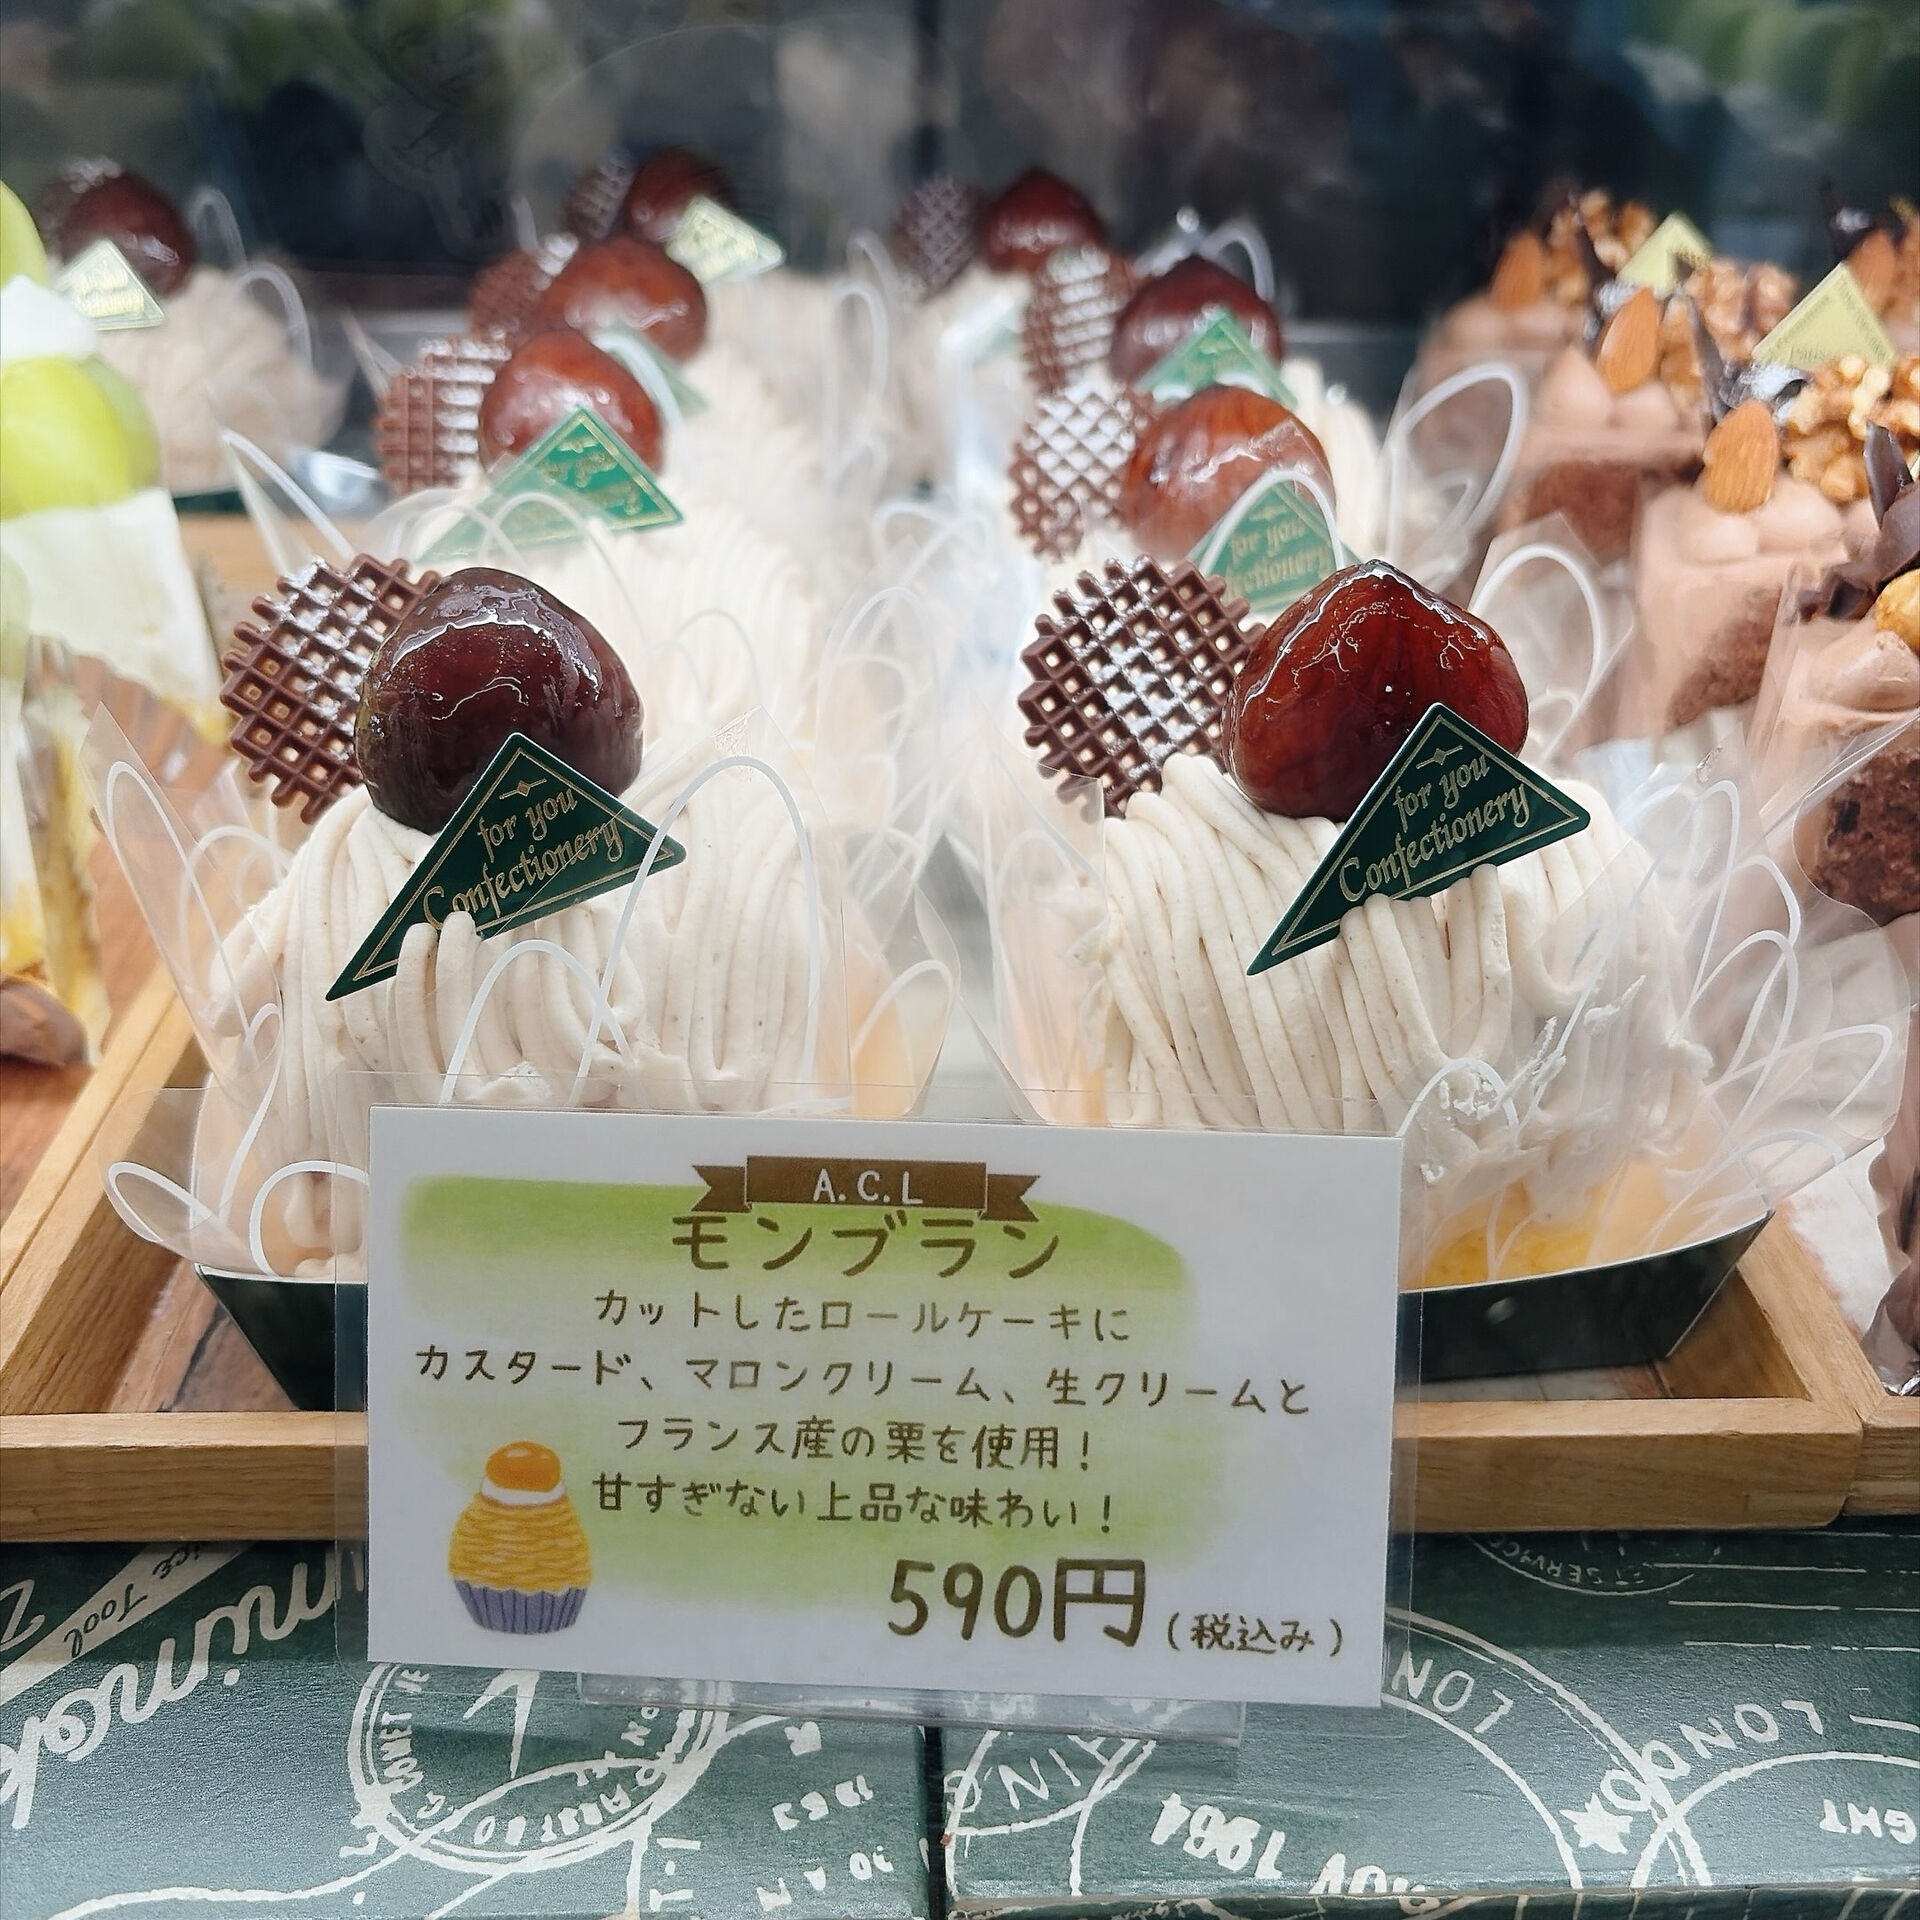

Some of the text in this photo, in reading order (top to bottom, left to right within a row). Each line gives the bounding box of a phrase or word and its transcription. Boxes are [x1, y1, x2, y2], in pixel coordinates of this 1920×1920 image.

[477, 786, 579, 864] for you
[1393, 753, 1491, 833] for you
[1338, 783, 1532, 903] Confectionery
[812, 1168, 923, 1206] A.C.L
[671, 1208, 1060, 1280] モンブラン
[593, 1288, 1130, 1342] カットしたロールケーキに
[415, 1343, 1311, 1417] カスタード、マロンクリーム、生クリームと
[616, 1413, 1091, 1472] フランス産の栗を使用！
[592, 1471, 1112, 1534] 甘すぎない上品な味わい！
[887, 1555, 1147, 1649] 590円
